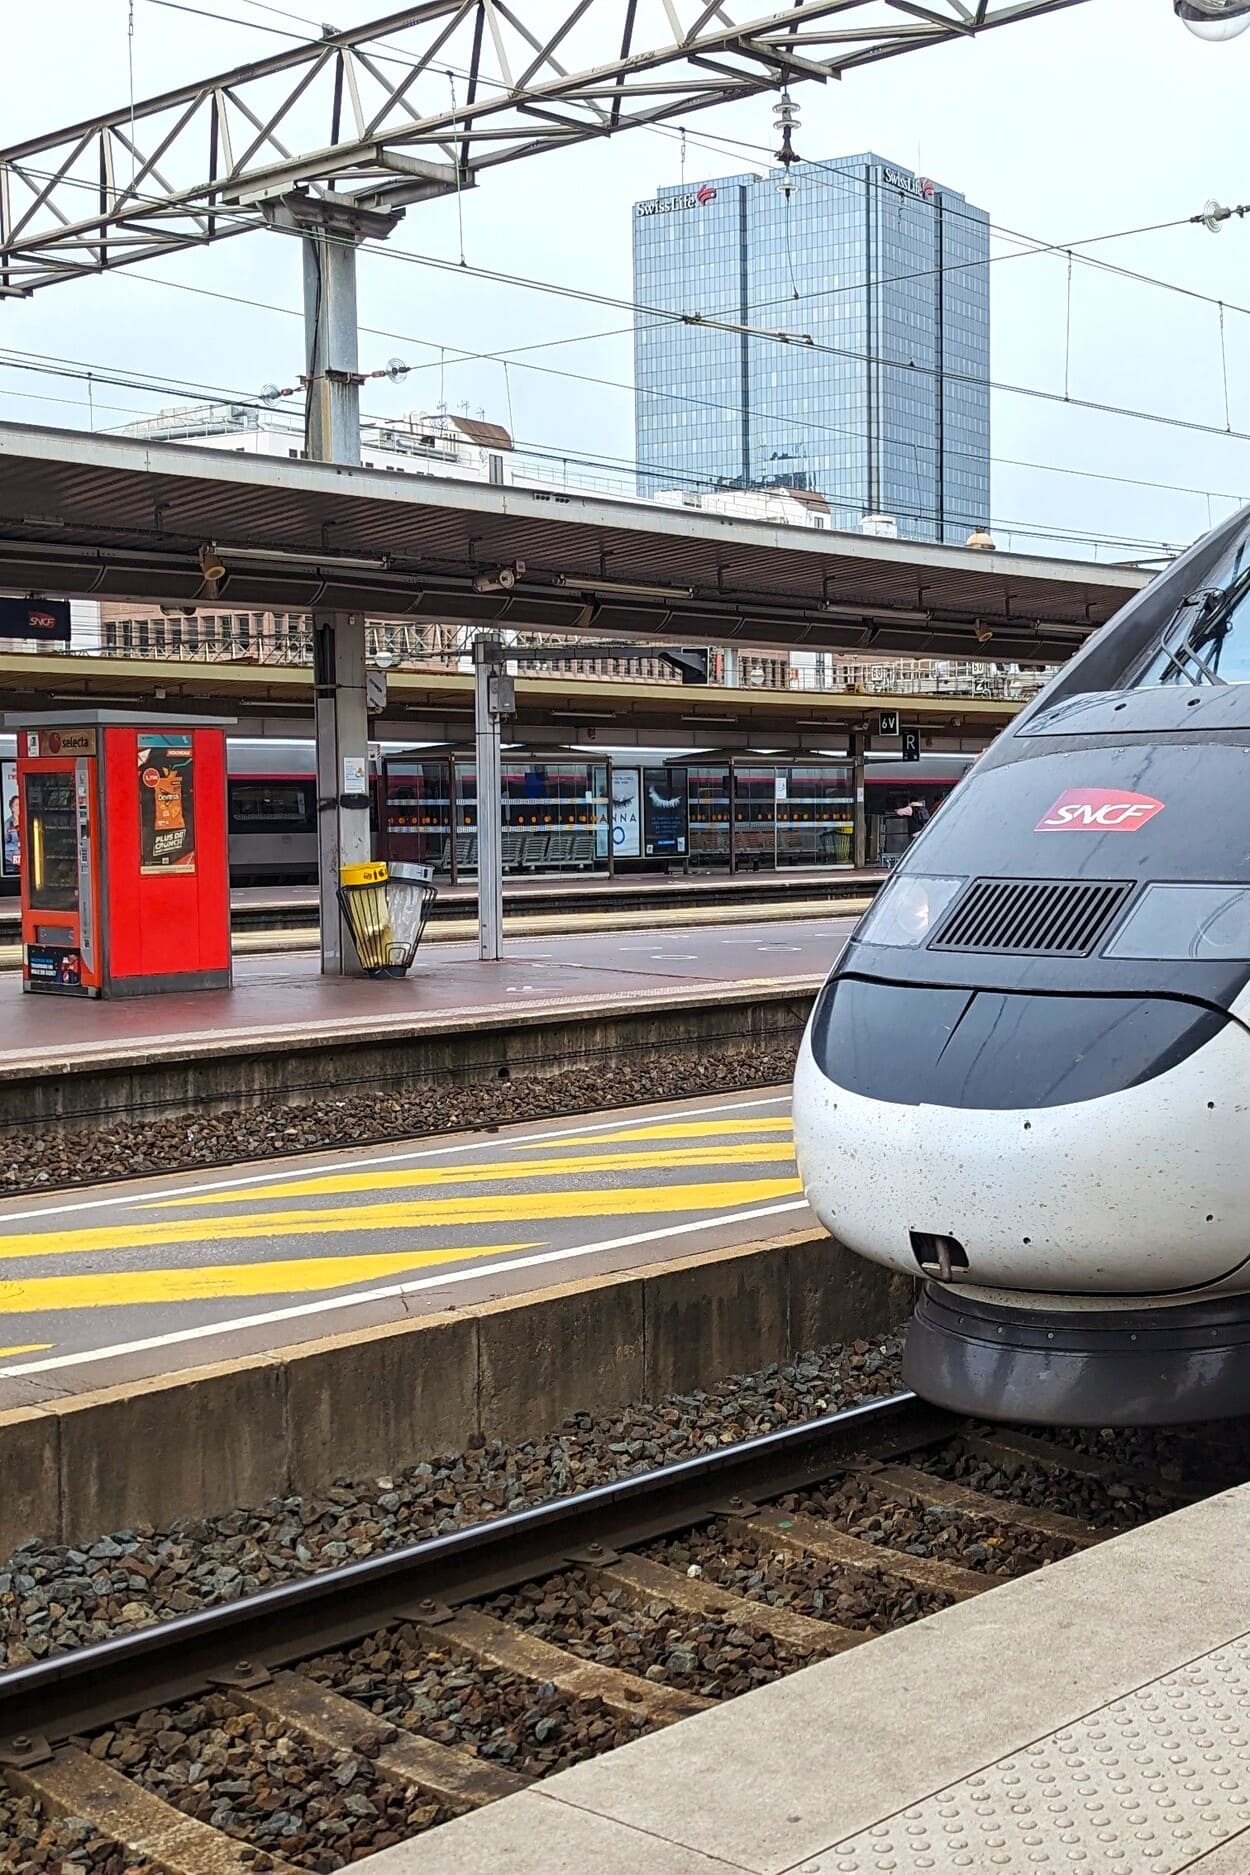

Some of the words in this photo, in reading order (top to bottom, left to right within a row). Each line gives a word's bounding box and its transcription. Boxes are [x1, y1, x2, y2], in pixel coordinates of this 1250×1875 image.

[29, 617, 56, 626] SNCF
[881, 717, 896, 729] 6V
[62, 736, 89, 748] selecta
[906, 734, 916, 750] R
[1043, 804, 1156, 825] SNCF
